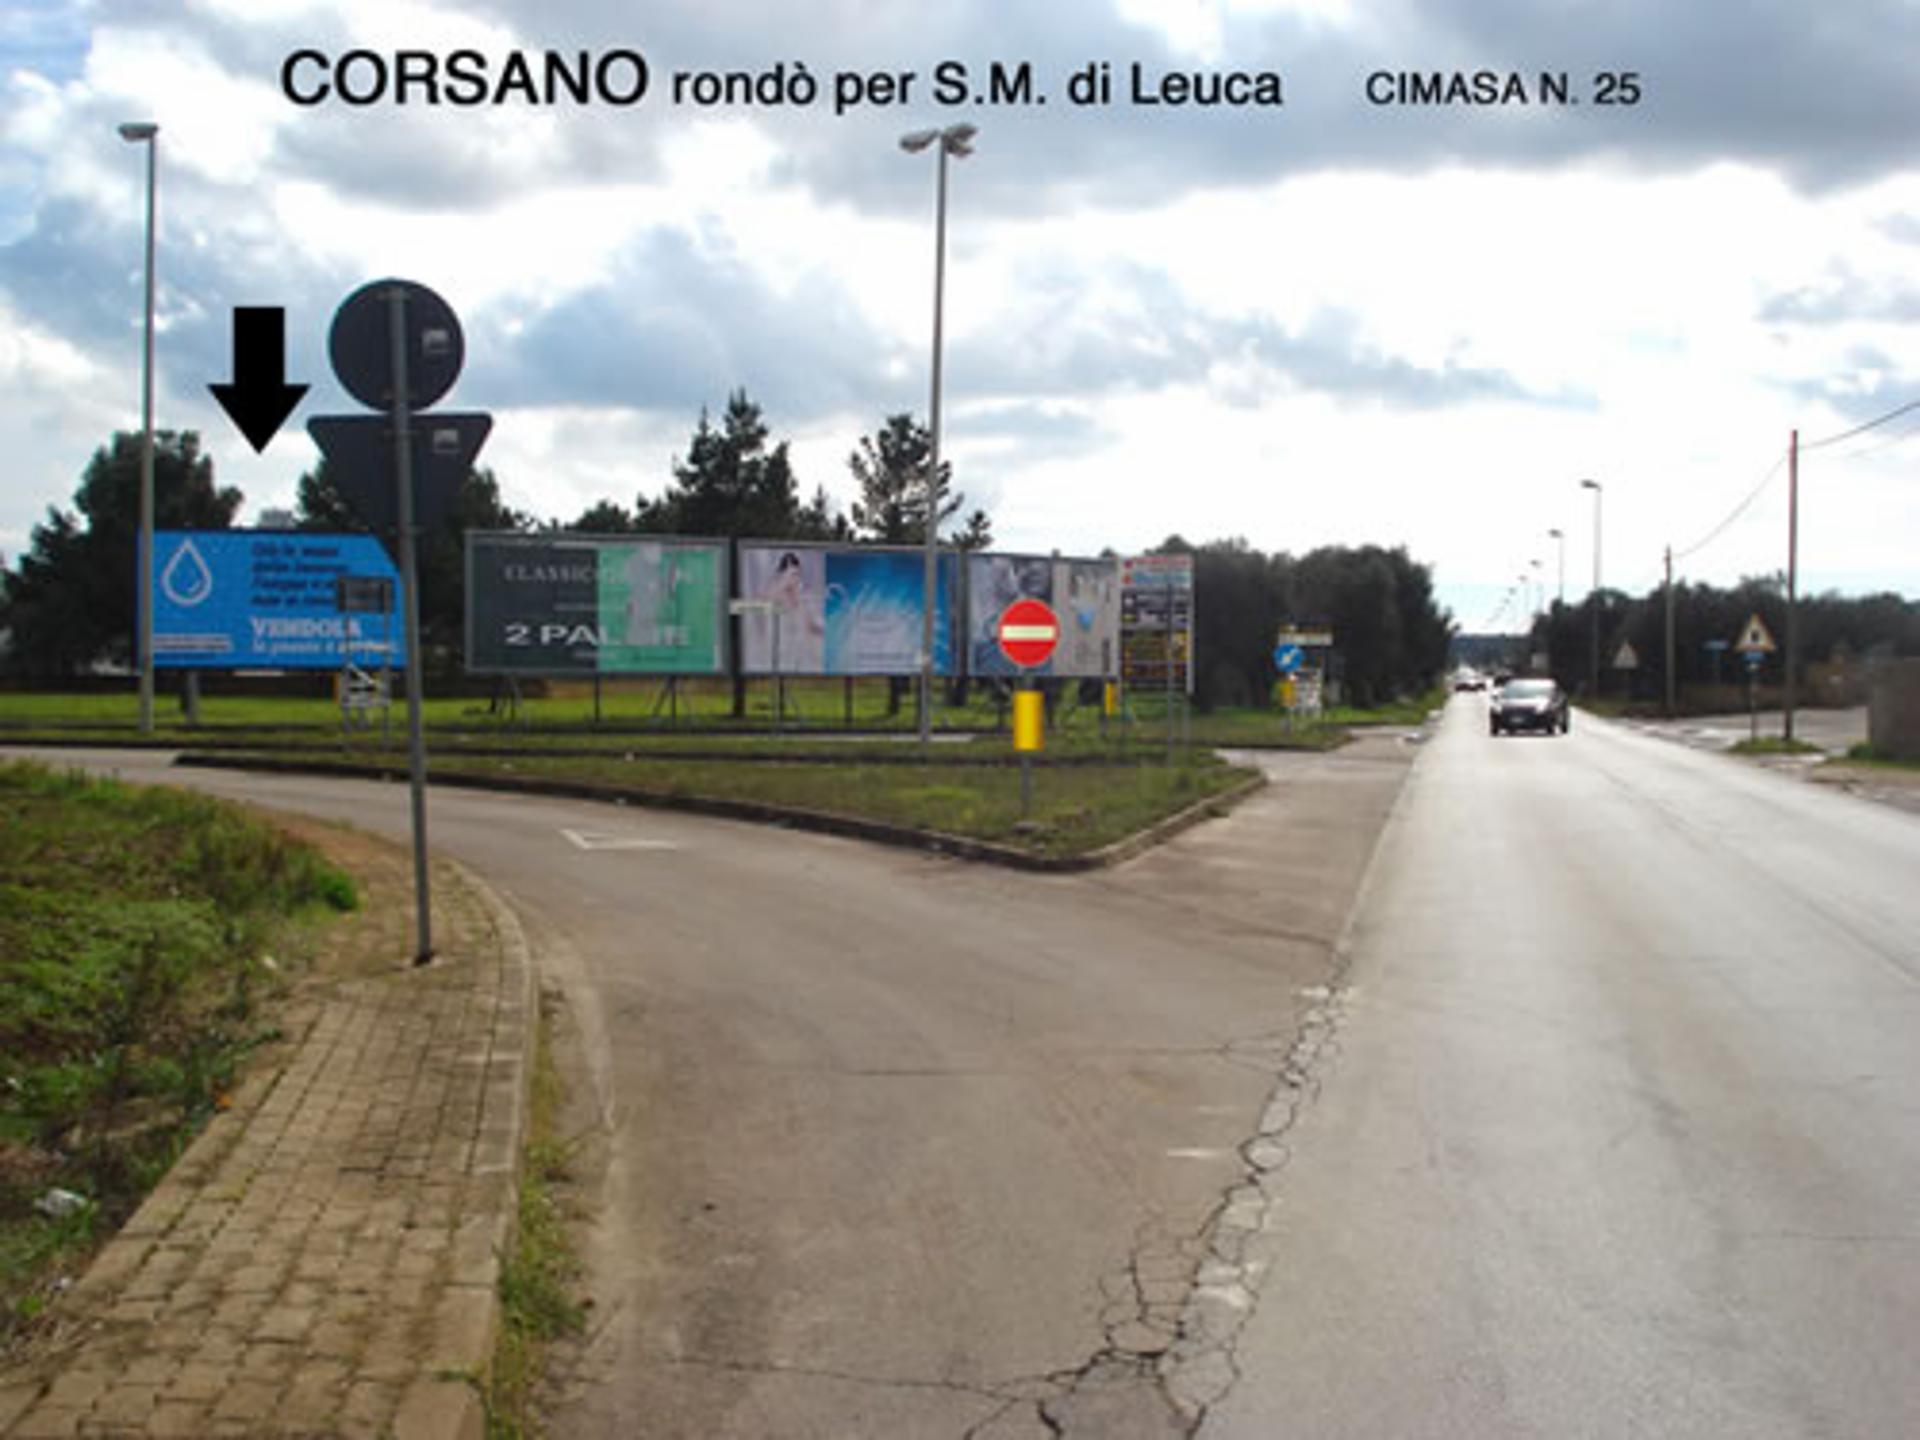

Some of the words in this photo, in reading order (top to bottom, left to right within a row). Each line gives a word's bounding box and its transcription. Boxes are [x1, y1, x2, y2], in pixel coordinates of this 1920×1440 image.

[504, 562, 600, 583] CLASSIC
[251, 616, 362, 638] VENDOLA
[505, 624, 530, 645] 2
